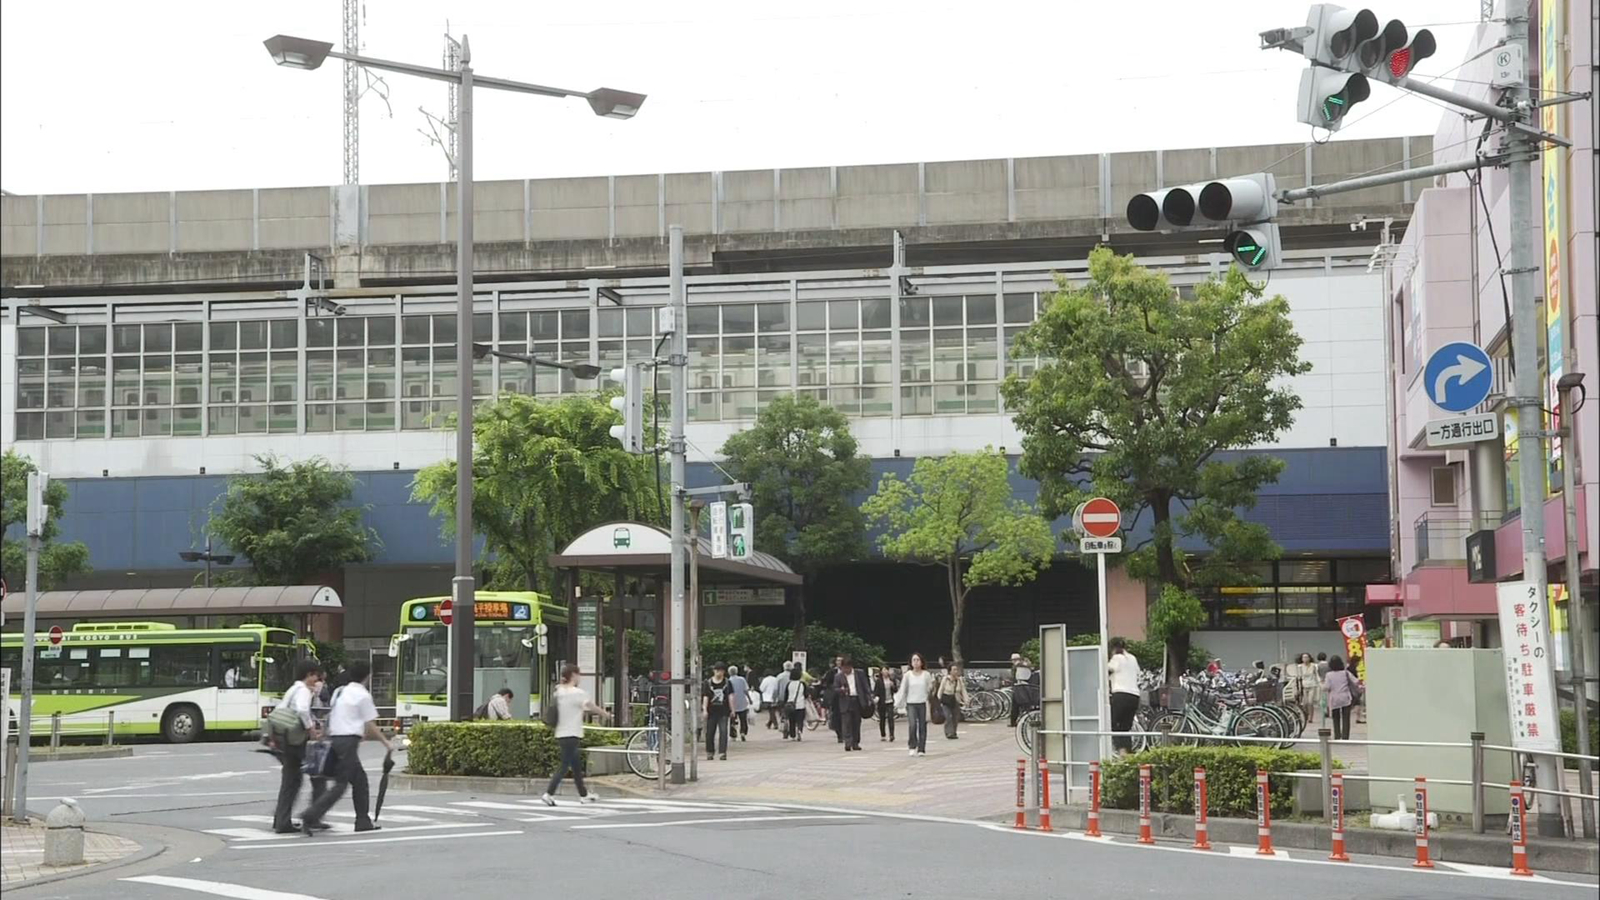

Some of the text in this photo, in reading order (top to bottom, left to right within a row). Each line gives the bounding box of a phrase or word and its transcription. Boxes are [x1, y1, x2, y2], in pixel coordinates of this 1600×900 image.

[1430, 418, 1494, 440] 一方通行出口
[1527, 586, 1545, 659] タクシーの
[1513, 603, 1540, 738] 客待ち駐車厳禁
[1416, 801, 1424, 836] 駐車禁止
[1511, 806, 1521, 842] 駐車禁止
